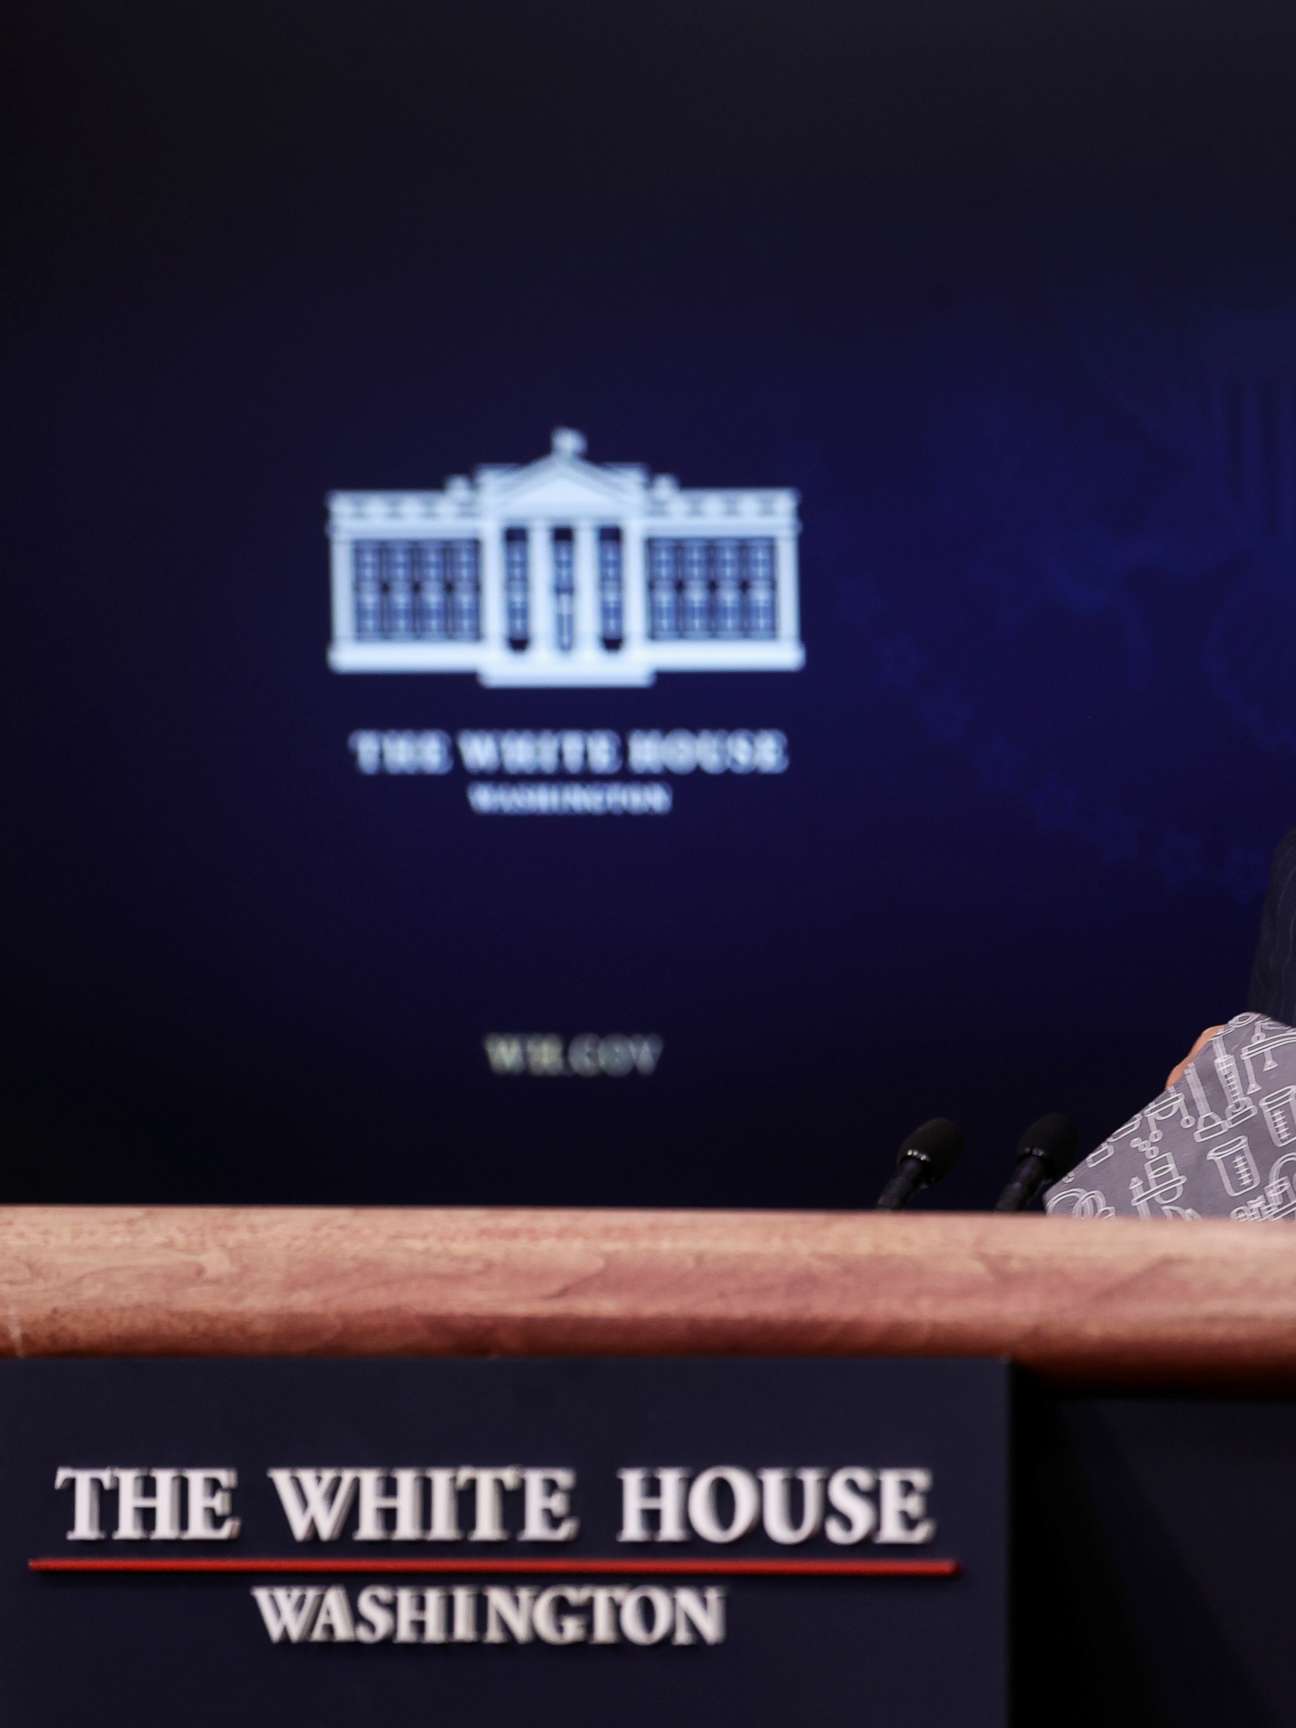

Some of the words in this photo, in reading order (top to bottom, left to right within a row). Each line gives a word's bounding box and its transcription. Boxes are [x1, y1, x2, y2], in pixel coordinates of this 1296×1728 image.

[349, 730, 452, 774] THE
[457, 730, 622, 774] WHITE
[627, 730, 789, 774] HOUSE
[54, 1466, 240, 1541] THE
[268, 1466, 578, 1542] WHITE
[618, 1466, 934, 1545] HOUSE
[252, 1585, 726, 1646] WASHINGTON
